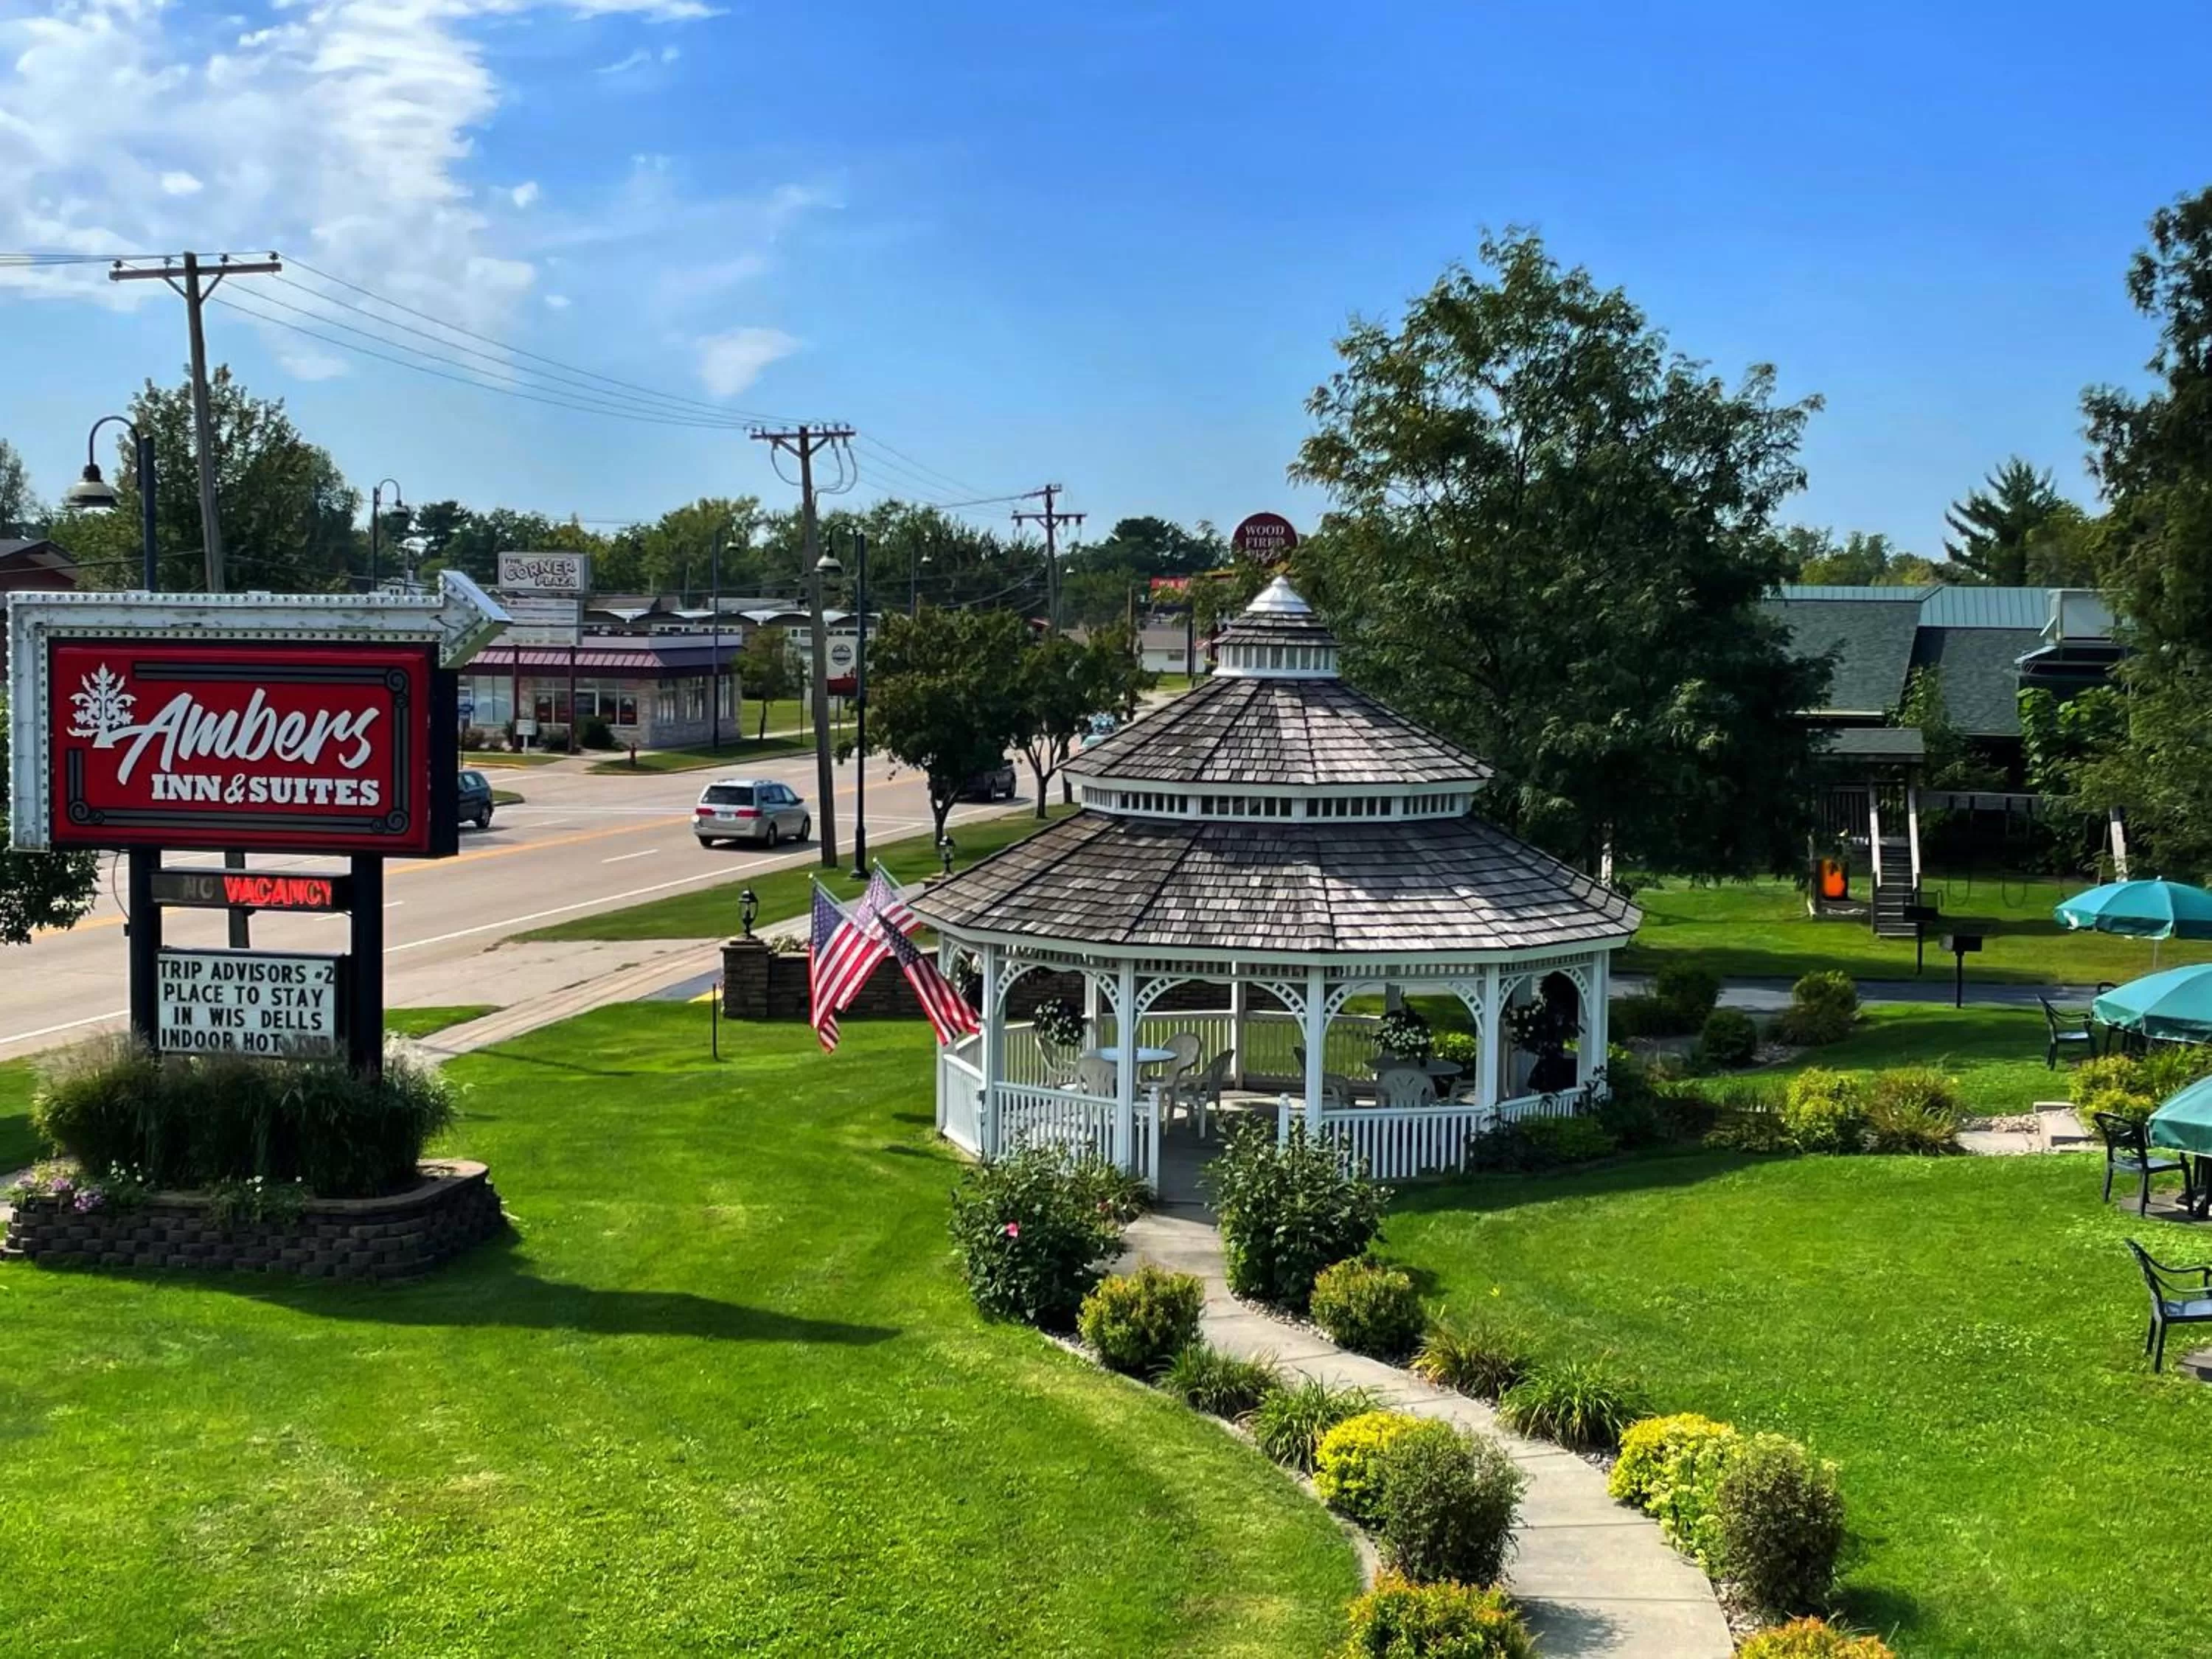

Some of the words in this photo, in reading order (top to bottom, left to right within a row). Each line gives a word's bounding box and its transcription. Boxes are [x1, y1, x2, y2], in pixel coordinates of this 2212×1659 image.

[1245, 525, 1285, 536] WOOD
[504, 560, 577, 581] CORNER
[535, 574, 577, 587] PLAZA
[114, 687, 380, 785] Ambers
[151, 773, 221, 801] INN
[248, 776, 380, 806] SUITES
[223, 875, 332, 906] VACANCY
[159, 960, 203, 979] TRIP
[211, 962, 307, 984] ADVISORS
[164, 983, 223, 1004] PLACE
[234, 985, 260, 1005] TO
[271, 987, 324, 1008] STAY
[173, 1006, 192, 1025] IN
[209, 1007, 246, 1028] WIS
[261, 1010, 323, 1030] DELLS
[161, 1029, 234, 1049] INDOOR
[243, 1032, 282, 1053] HOT
